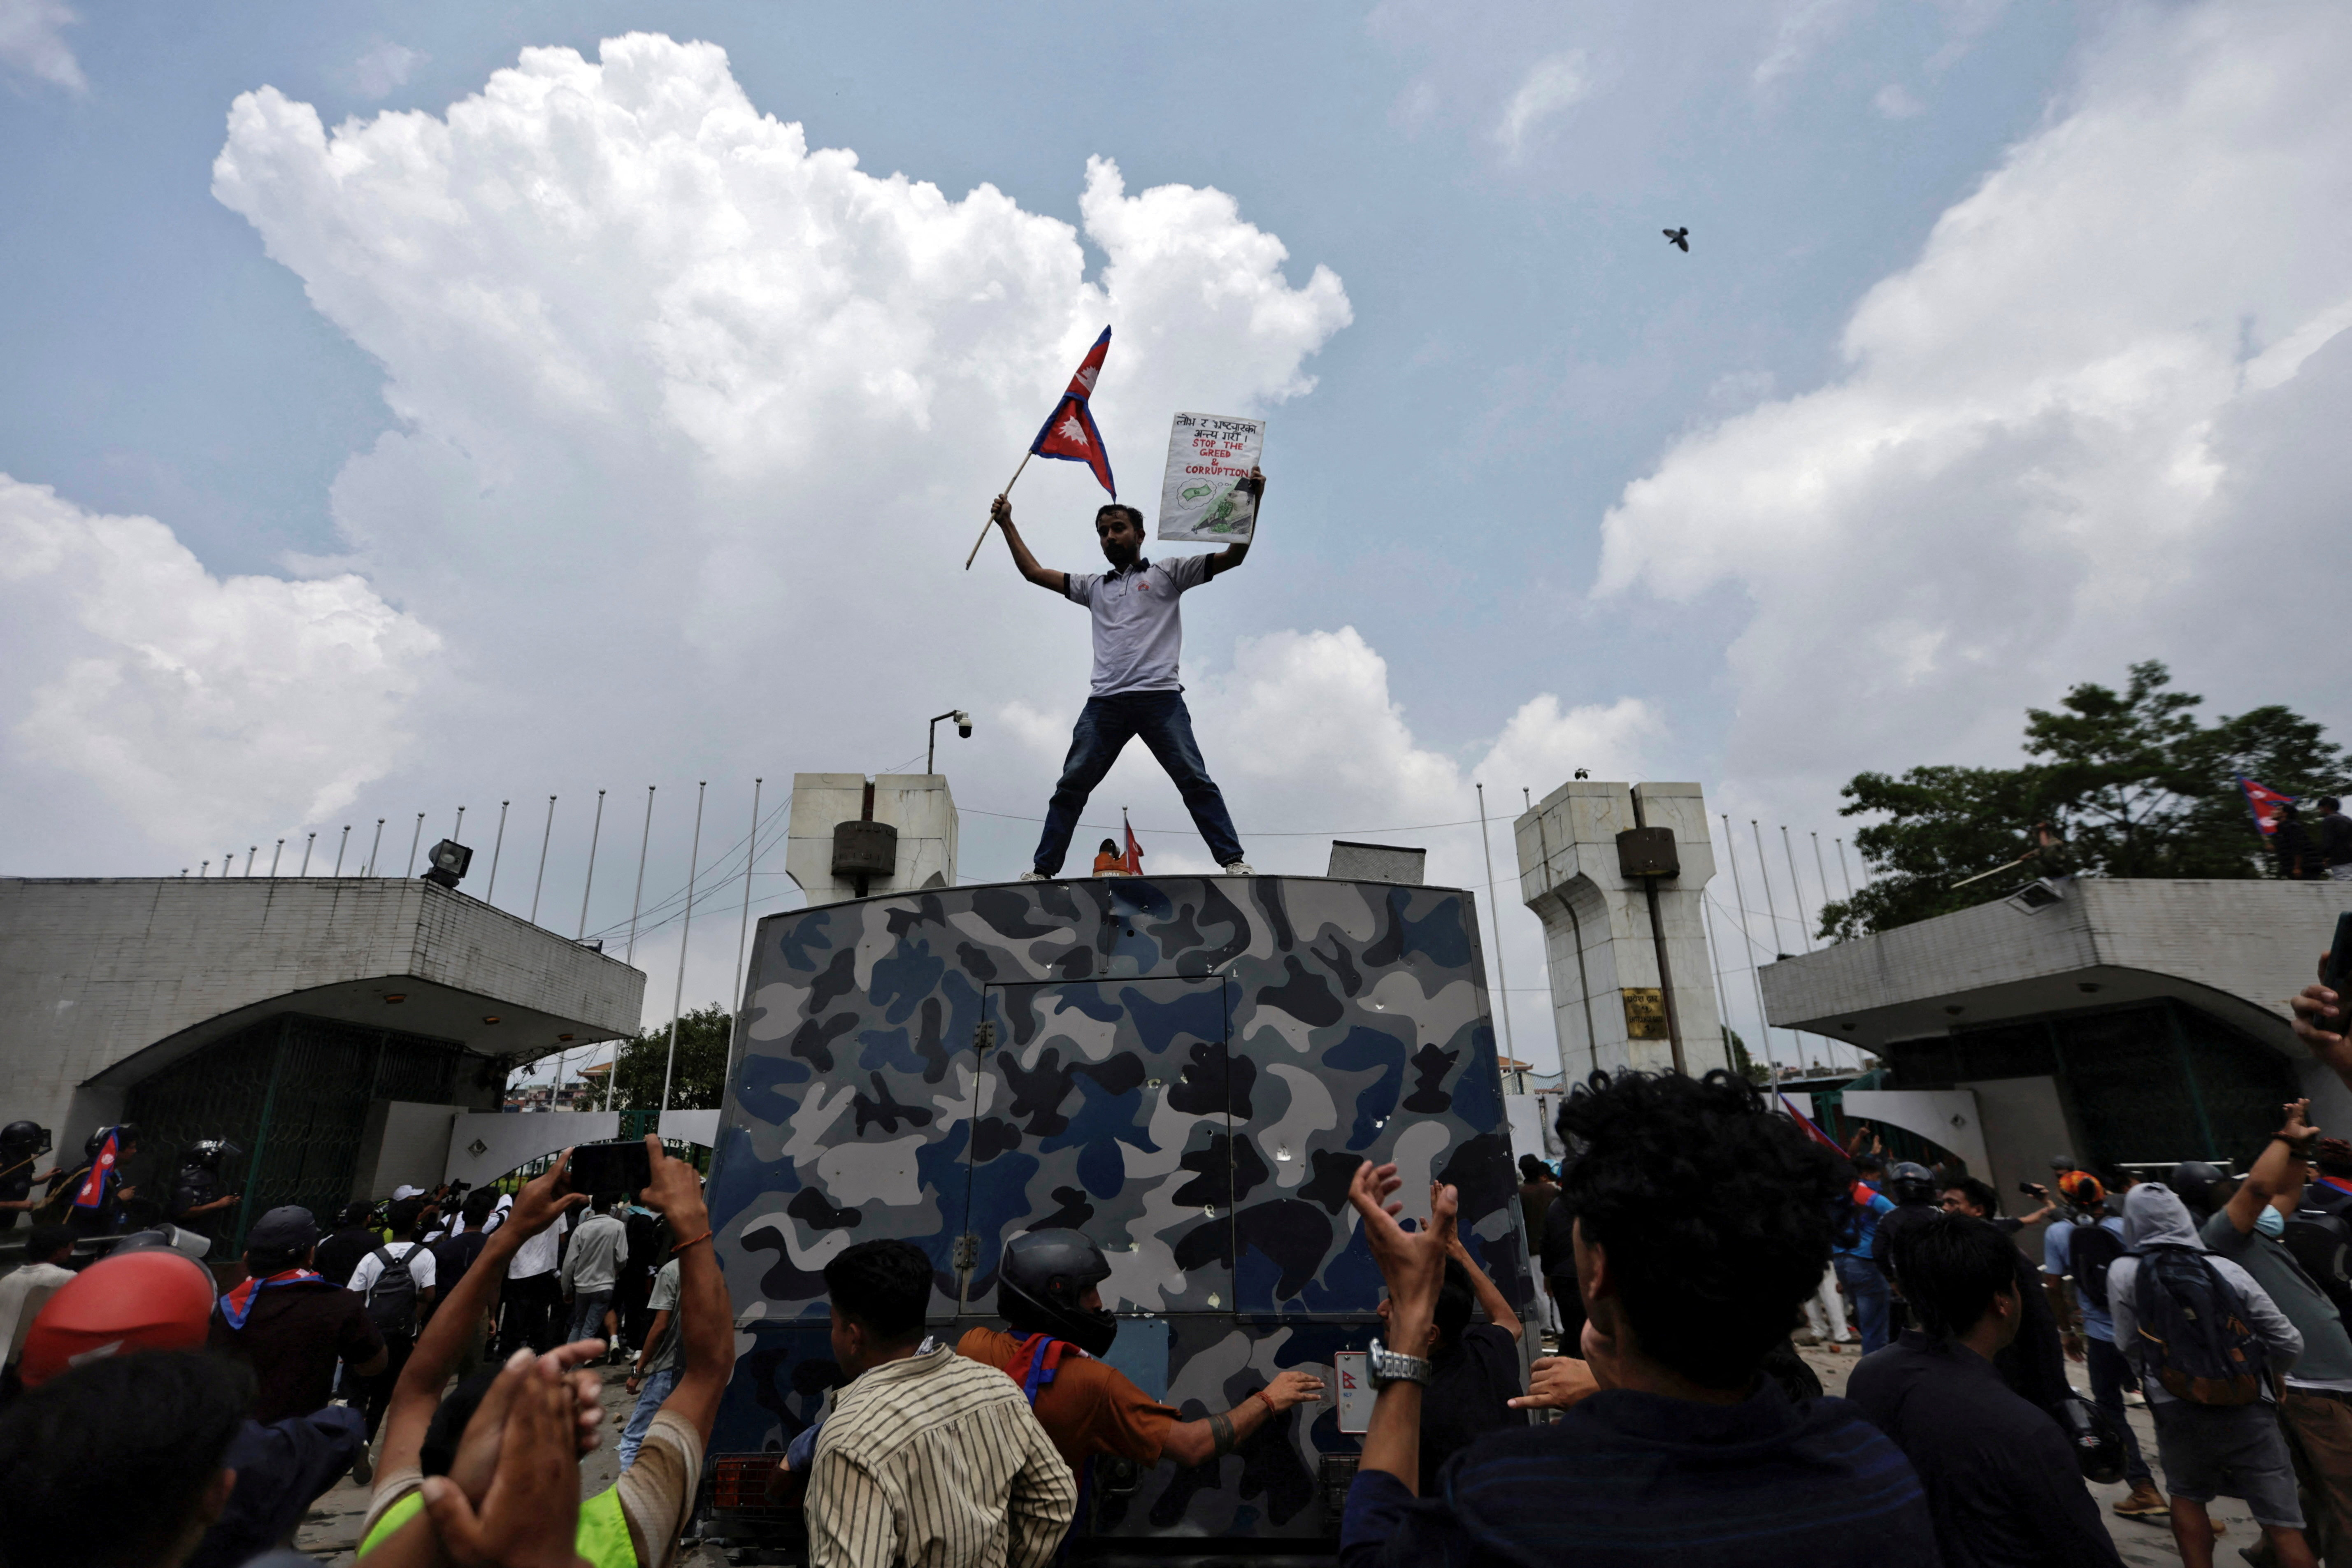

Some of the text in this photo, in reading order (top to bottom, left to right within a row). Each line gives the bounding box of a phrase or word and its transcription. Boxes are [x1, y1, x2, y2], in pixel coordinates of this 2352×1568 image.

[1201, 419, 1208, 427] र
[1192, 439, 1243, 450] STOP THE
[1200, 448, 1231, 458] GREED
